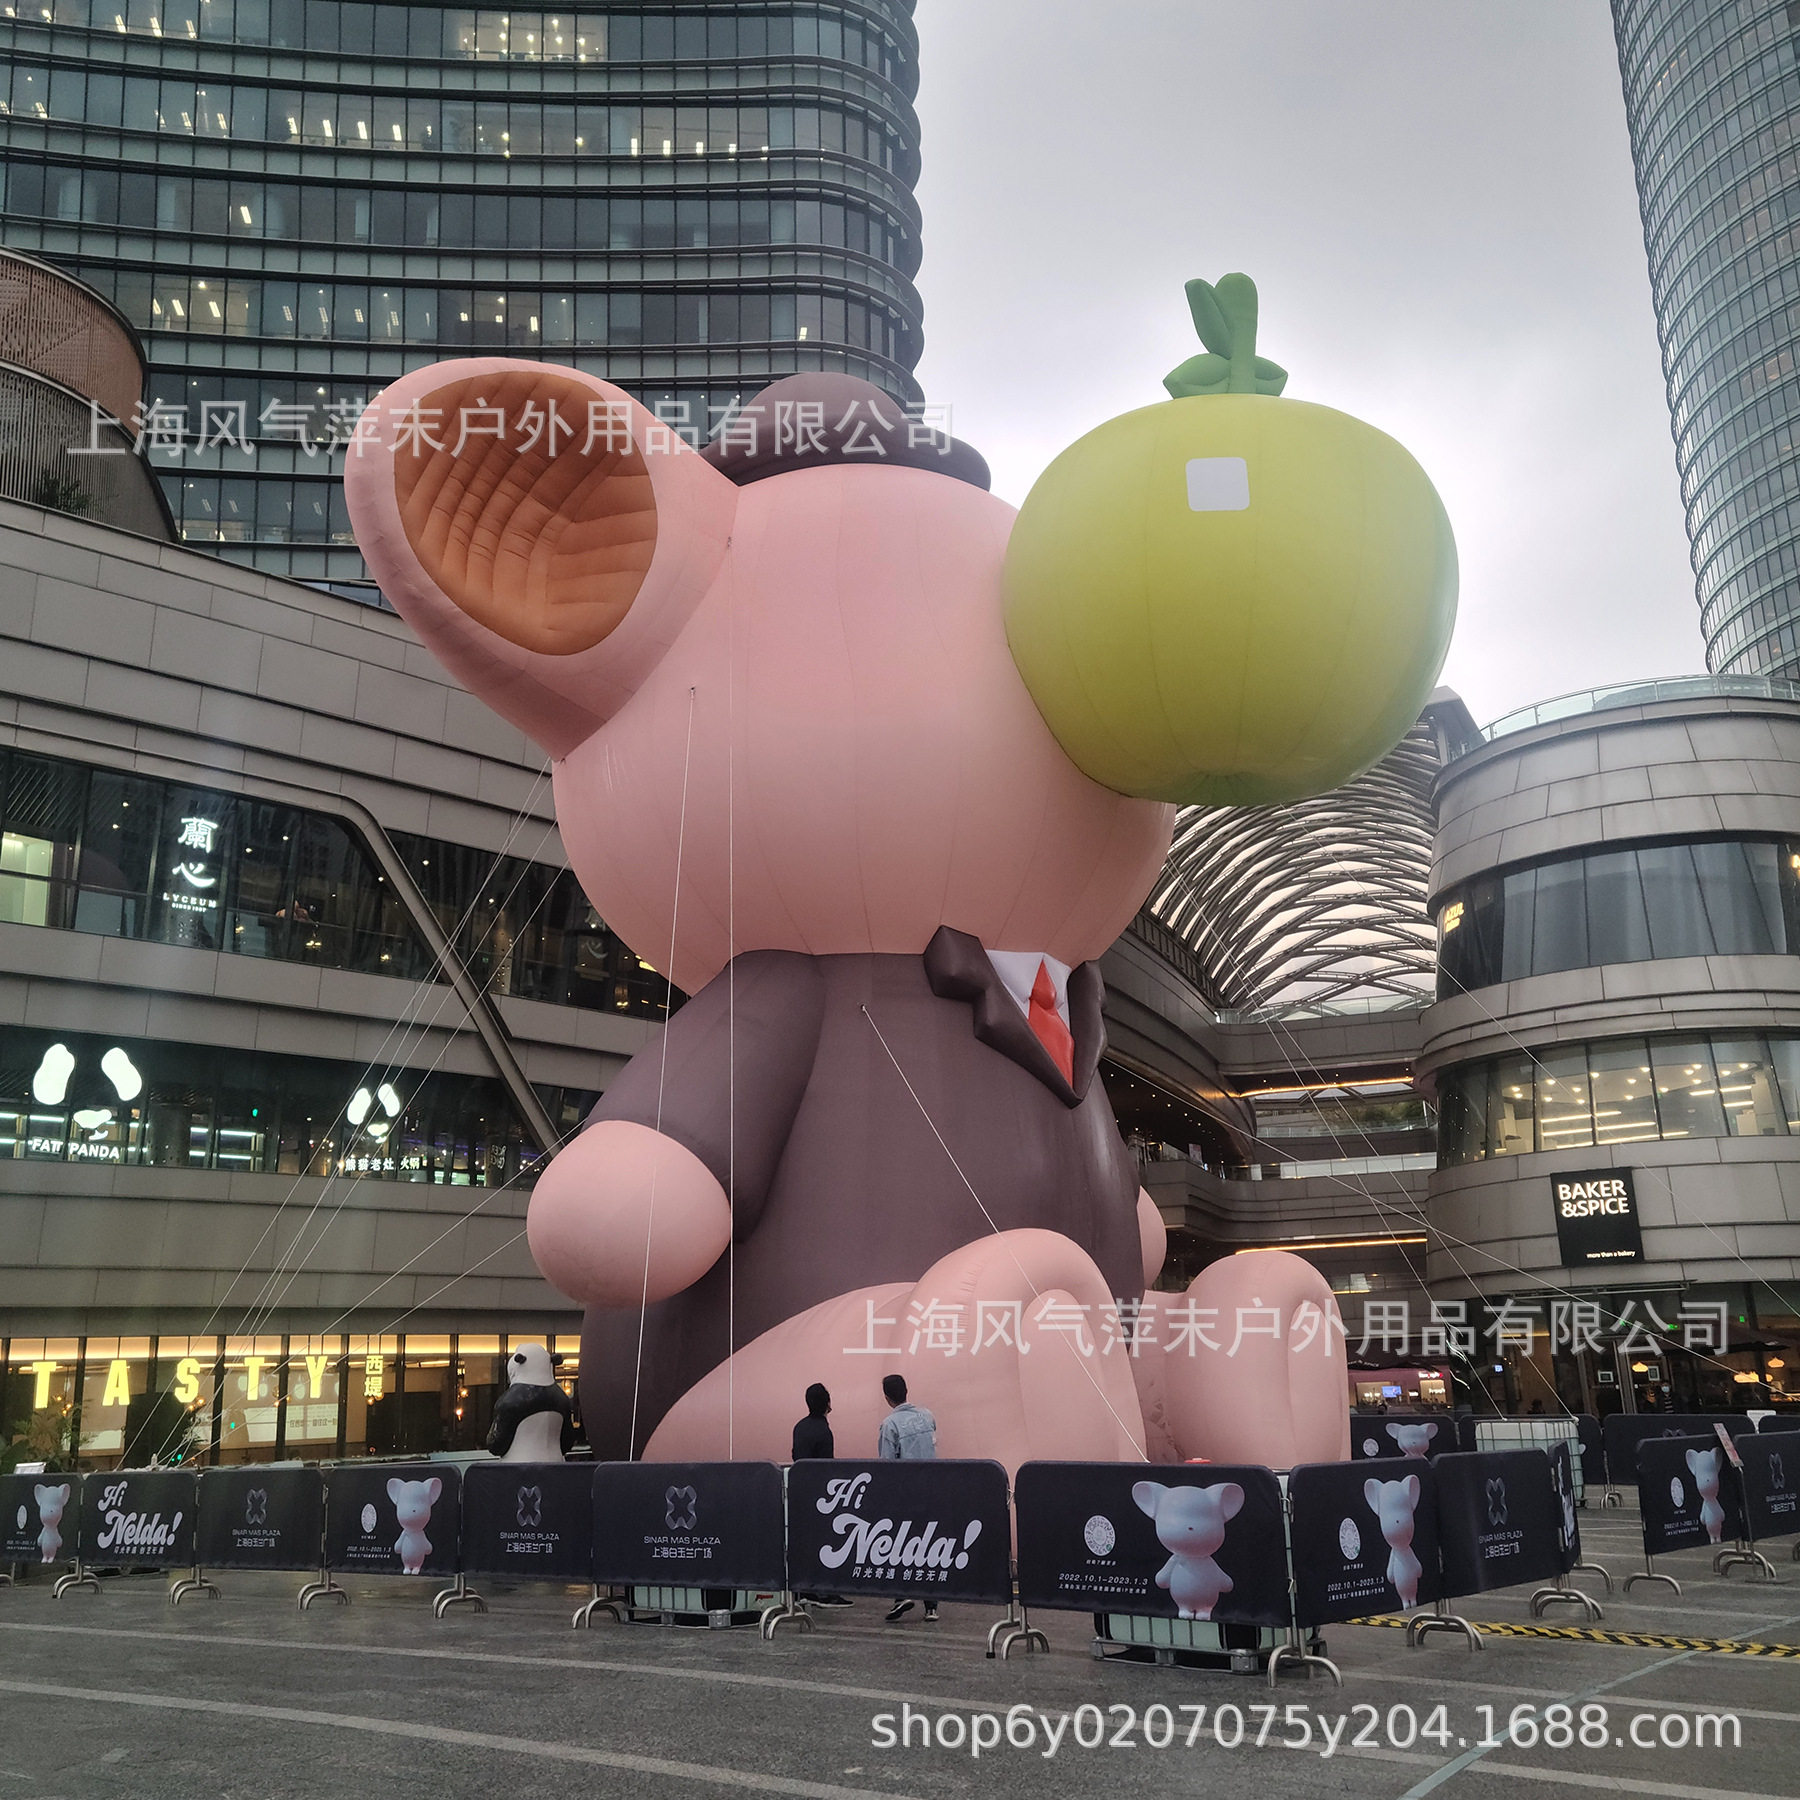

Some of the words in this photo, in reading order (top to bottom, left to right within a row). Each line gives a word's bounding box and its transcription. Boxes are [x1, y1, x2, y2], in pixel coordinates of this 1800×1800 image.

[163, 892, 217, 908] LYCEUM
[68, 1142, 120, 1159] PANDA
[1558, 1180, 1627, 1200] BAKER
[1561, 1197, 1630, 1218] &SPICE
[32, 1355, 328, 1409] TASTY
[364, 1355, 384, 1397] 西堤
[98, 1481, 128, 1511] Hi
[816, 1472, 872, 1515] Hi
[97, 1510, 183, 1549] Nelda!
[499, 1531, 519, 1540] SINAR
[520, 1532, 536, 1540] MAS
[537, 1533, 560, 1541] PLAZA
[644, 1535, 669, 1544] SINAR
[670, 1536, 690, 1545] MAS
[692, 1536, 721, 1545] PLAZA
[819, 1513, 983, 1570] Nelda!
[652, 1546, 713, 1559] 上海白玉兰广场
[852, 1566, 896, 1579] 闪光奇遇
[903, 1569, 949, 1582] 创艺无限
[1059, 1573, 1148, 1586] 2022.10.1-2023.1.3
